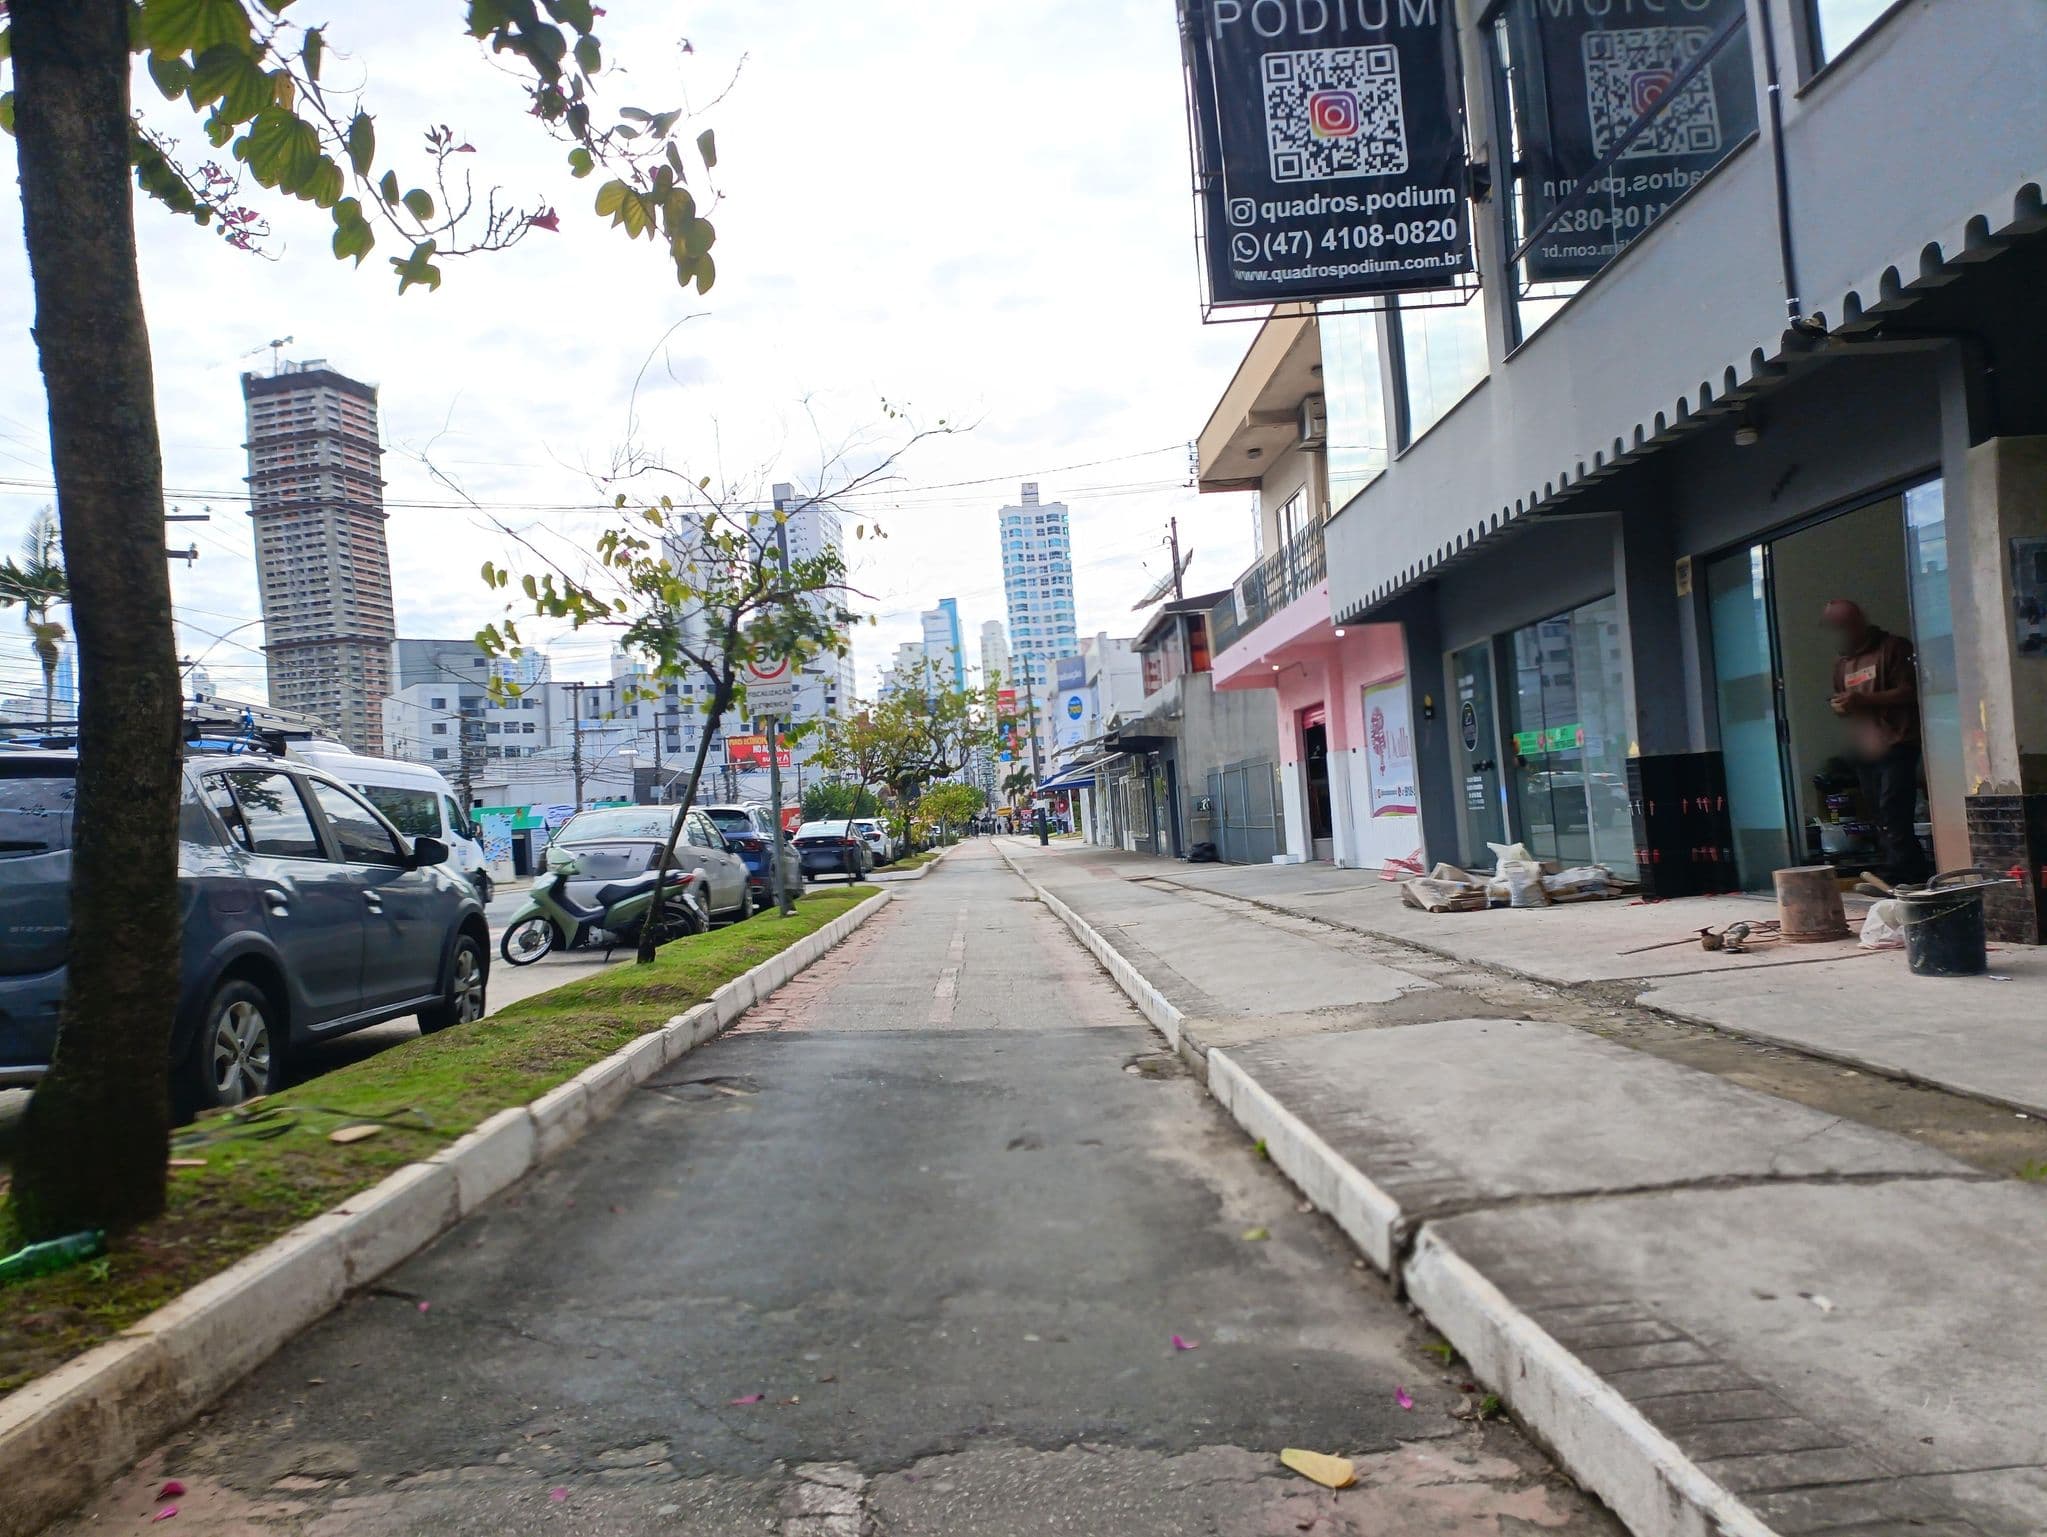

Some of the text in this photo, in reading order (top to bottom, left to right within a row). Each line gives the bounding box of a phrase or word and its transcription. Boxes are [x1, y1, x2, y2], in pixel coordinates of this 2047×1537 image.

[1213, 0, 1437, 40] PODIUM
[1260, 186, 1455, 224] quadros.podium
[1263, 217, 1458, 262] (47) 4108-0820
[1233, 252, 1464, 284] www.quadrospodium.com.br
